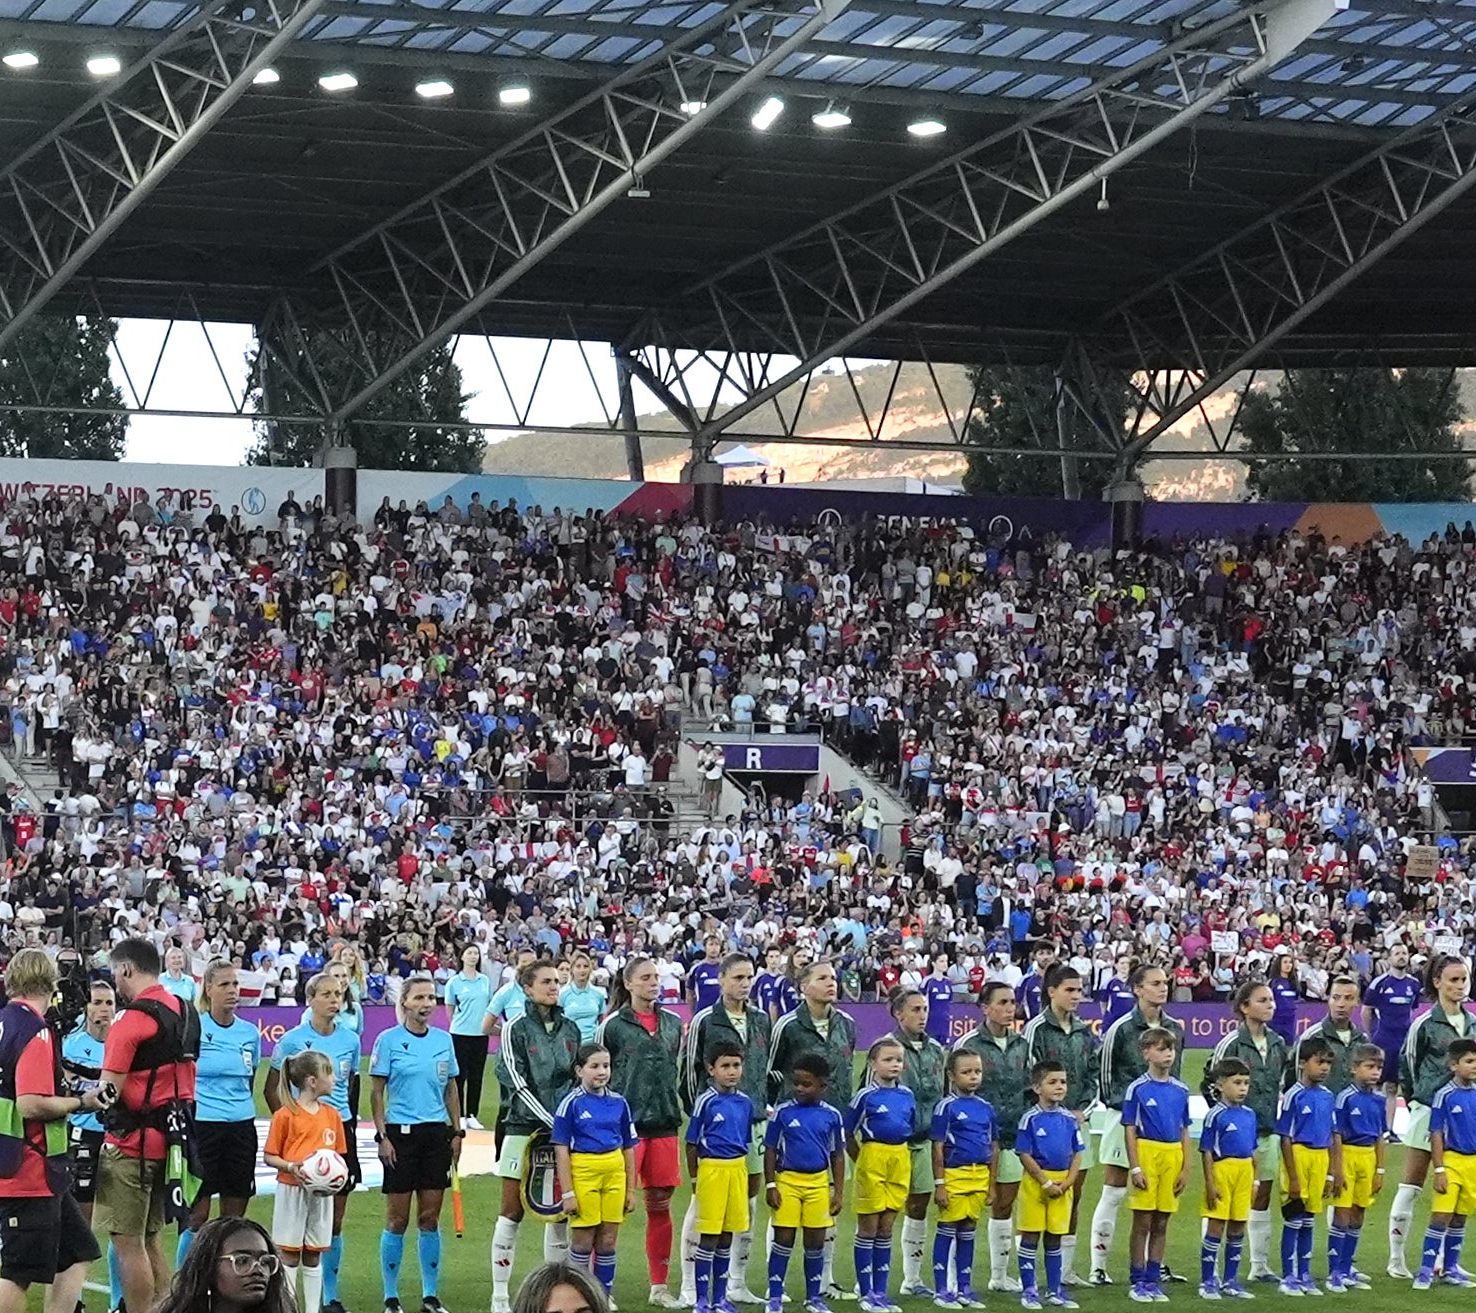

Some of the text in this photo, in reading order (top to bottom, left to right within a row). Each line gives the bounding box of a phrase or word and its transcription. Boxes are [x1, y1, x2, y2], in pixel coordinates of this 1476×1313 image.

[747, 748, 761, 769] R
[948, 1016, 977, 1037] isit
[1191, 1017, 1213, 1036] to
